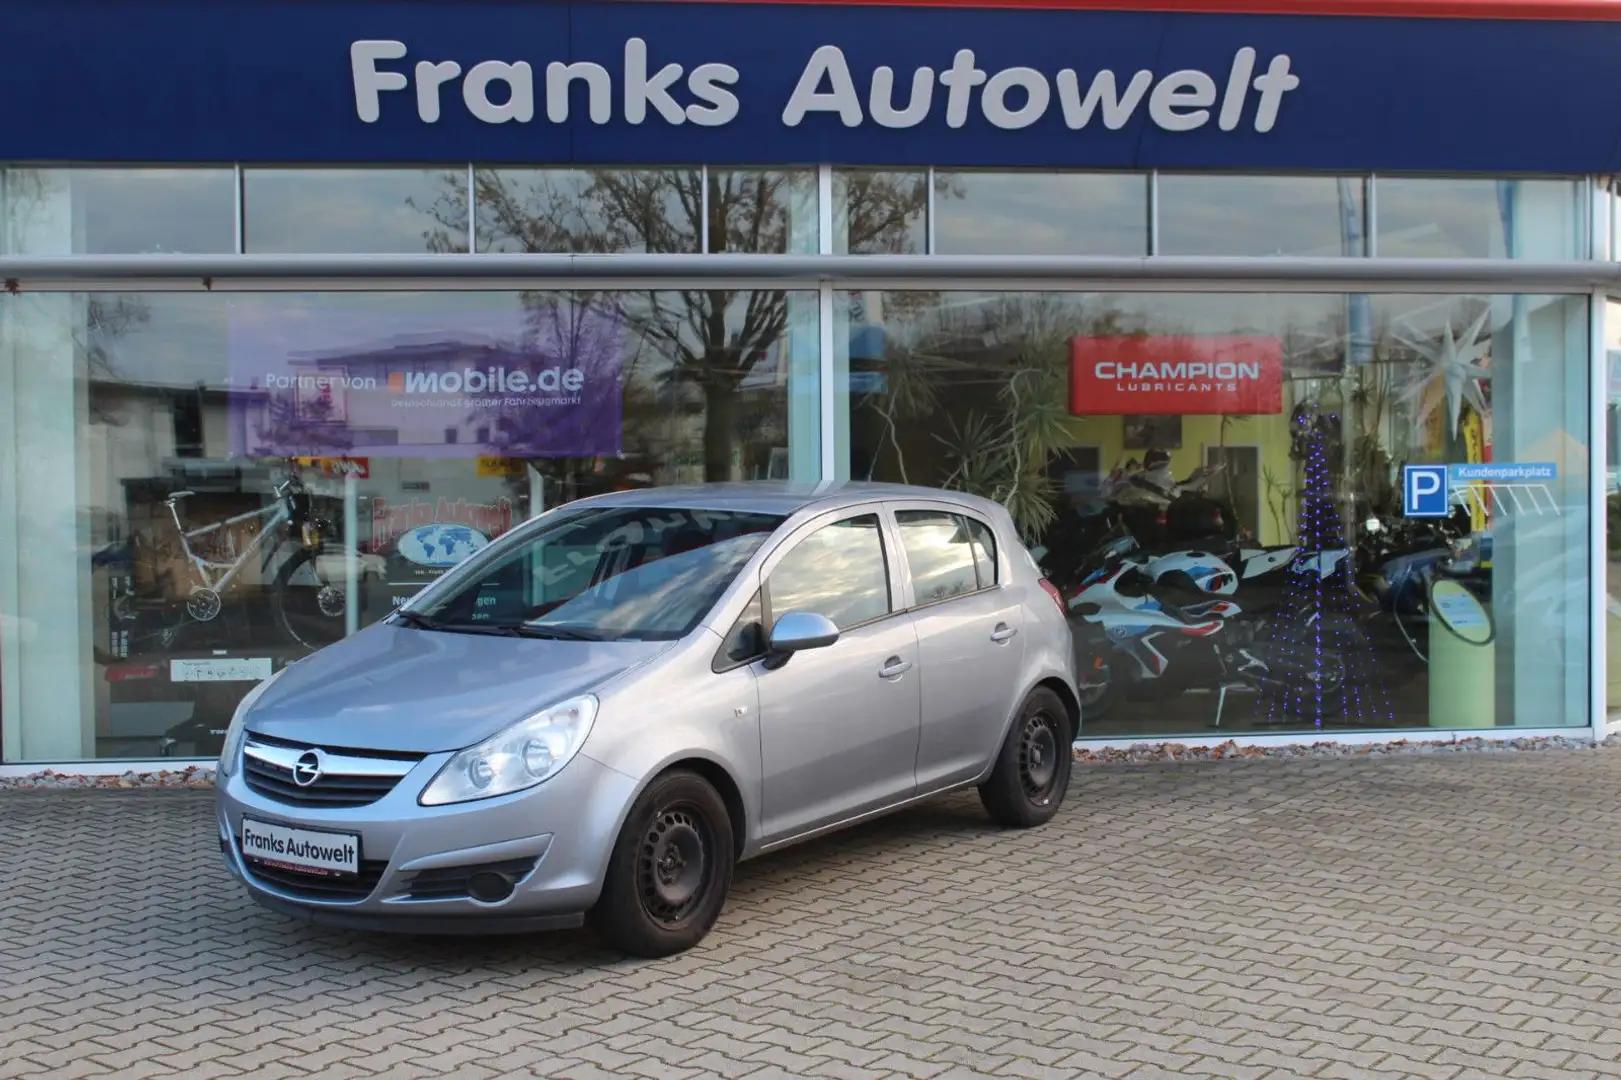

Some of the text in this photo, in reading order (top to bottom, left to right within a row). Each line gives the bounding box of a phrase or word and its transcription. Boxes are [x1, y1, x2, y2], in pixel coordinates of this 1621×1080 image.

[350, 37, 1300, 134] Franks Autowelt
[266, 366, 585, 394] Partner von mobile.de
[1095, 361, 1260, 380] CHAMPION
[1116, 383, 1238, 392] LUBRICANTS
[1458, 466, 1552, 479] Kundenparkplatz
[1411, 471, 1441, 510] P
[245, 828, 355, 864] Franks Autowelt
